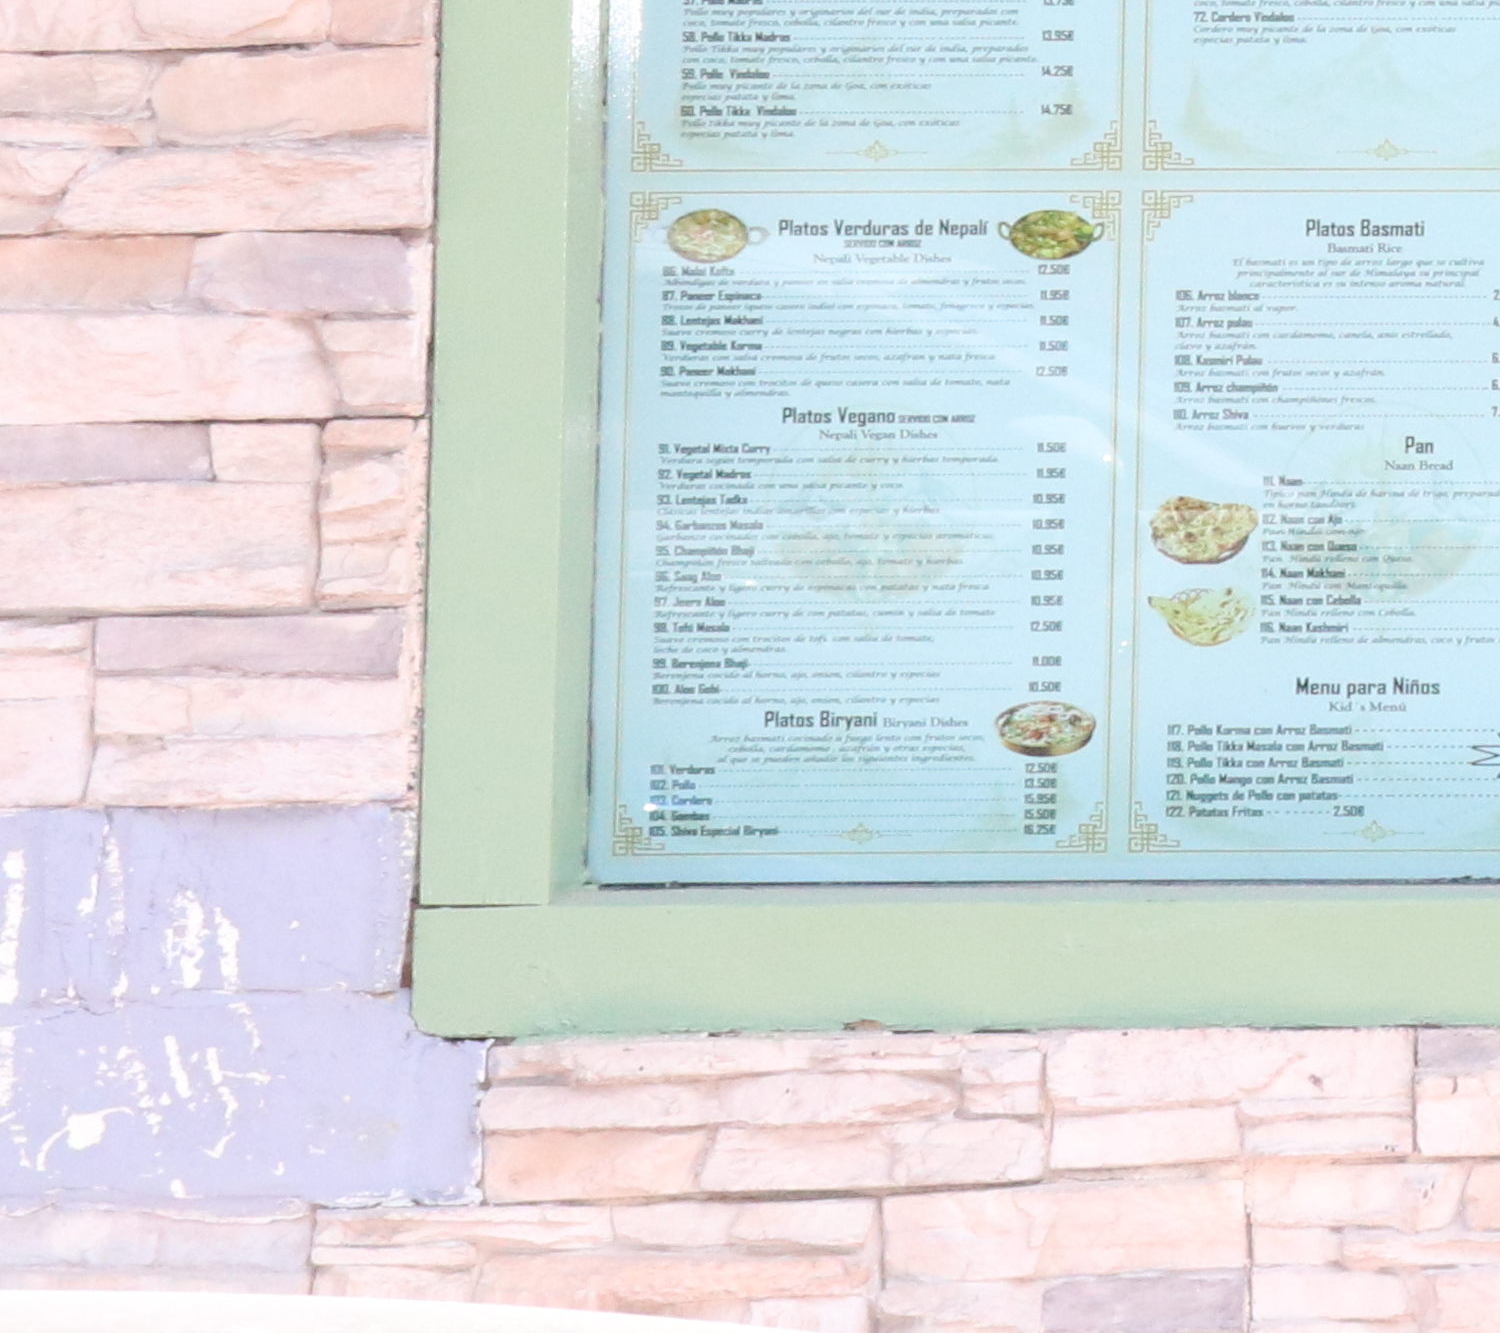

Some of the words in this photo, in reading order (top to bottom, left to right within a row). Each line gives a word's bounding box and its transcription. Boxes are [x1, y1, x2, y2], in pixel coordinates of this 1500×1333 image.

[779, 219, 828, 236] Platos
[834, 219, 909, 236] Verduras
[915, 219, 933, 236] de
[939, 219, 987, 238] Nepalí
[1306, 219, 1355, 236] Platos
[1361, 219, 1424, 236] Basmati
[1328, 243, 1373, 253] Basmati
[1377, 243, 1402, 253] Rice
[782, 407, 832, 423] Platos
[838, 407, 895, 426] Vegano
[1405, 436, 1434, 454] Pan
[1384, 460, 1415, 470] Naan
[1419, 460, 1453, 471] Bread
[1296, 677, 1340, 695] Menu
[1347, 683, 1386, 698] para
[1393, 677, 1439, 694] Niños
[765, 711, 814, 727] Platos
[820, 711, 877, 731] Biryani
[1188, 805, 1229, 817] Patatas
[1232, 806, 1264, 817] Fritas
